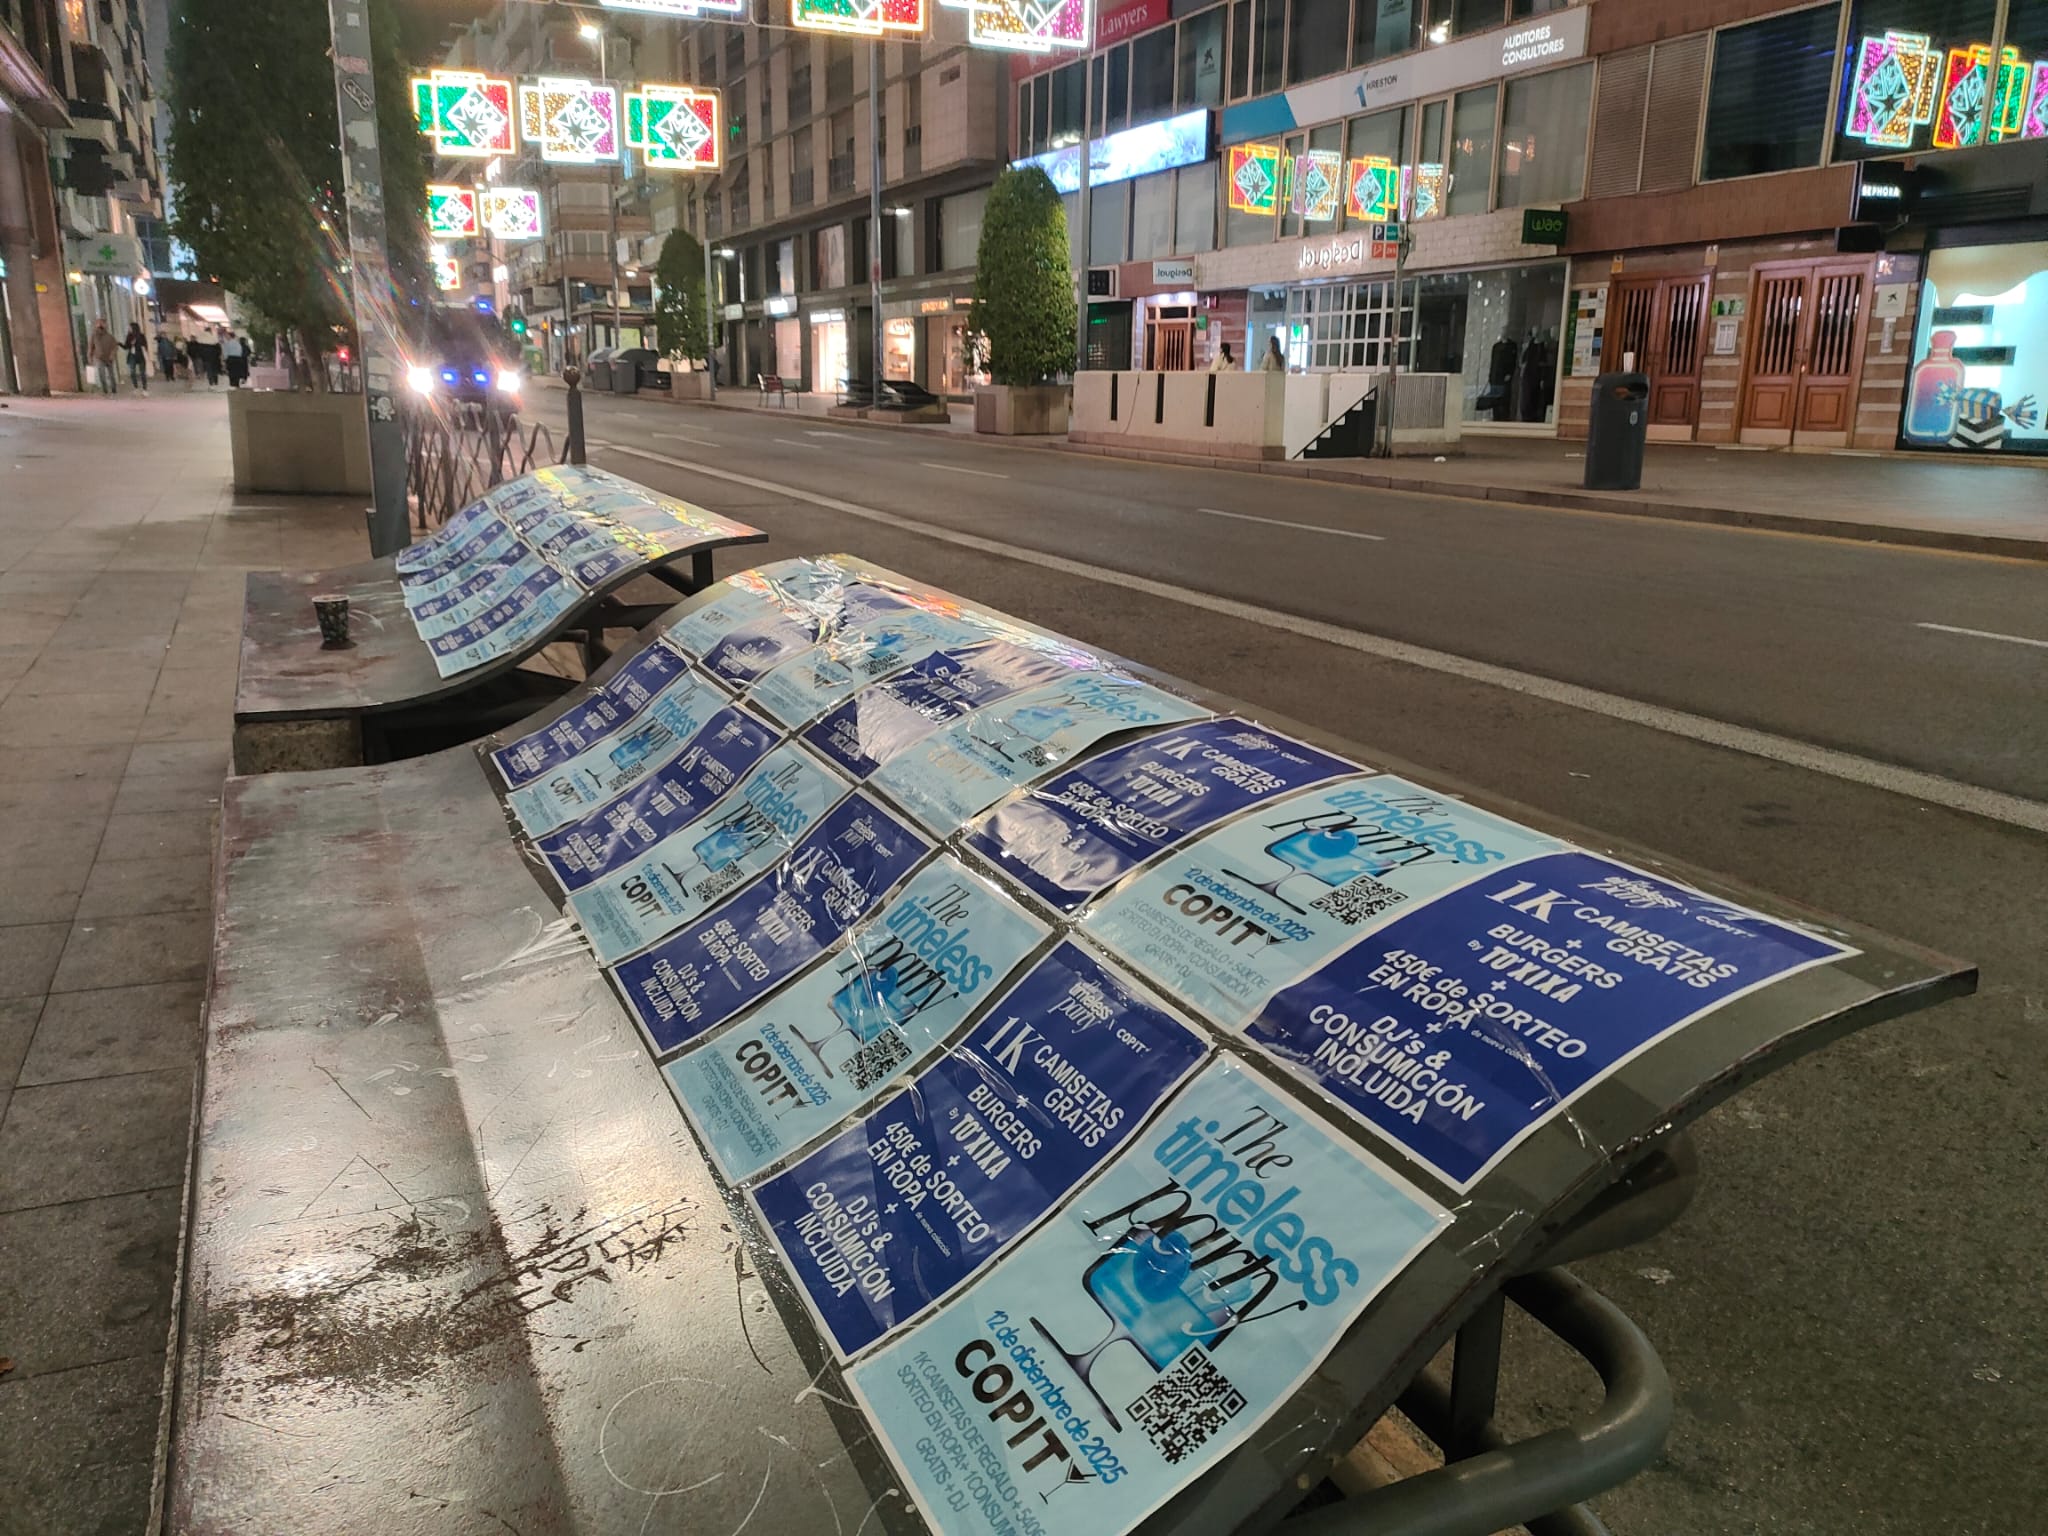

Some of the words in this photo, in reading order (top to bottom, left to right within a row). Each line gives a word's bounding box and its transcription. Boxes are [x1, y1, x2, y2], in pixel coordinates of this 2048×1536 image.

[1100, 4, 1148, 36] Lawyers
[1503, 25, 1550, 50] AUDITORES
[1502, 38, 1565, 65] CONSULTORES
[1862, 184, 1901, 197] SEPHORA
[1375, 225, 1382, 239] P
[1140, 761, 1210, 796] BURGERS
[1151, 736, 1212, 761] 1K
[1201, 748, 1286, 789] CAMISETAS
[1211, 766, 1269, 794] GRATIS
[744, 770, 808, 835] timeless
[1109, 803, 1169, 838] SORTEO
[1323, 790, 1506, 865] timeless
[1383, 794, 1449, 817] The
[1262, 810, 1460, 869] party
[773, 890, 816, 932] BURGERS
[924, 883, 970, 928] The
[1208, 880, 1265, 916] diciembre
[1274, 918, 1316, 942] 2025
[1484, 880, 1584, 924] 1K
[1573, 906, 1739, 979] CAMISETAS
[732, 941, 770, 982] SORTEO
[885, 896, 993, 994] timeless
[1487, 923, 1623, 990] BURGERS
[1606, 938, 1717, 989] GRATIS
[640, 976, 678, 1022] INCLUIDA
[652, 958, 702, 1023] CONSUMICIÓN
[836, 934, 960, 1018] party
[1068, 981, 1114, 1020] timeless
[1367, 964, 1411, 991] EN
[1403, 984, 1477, 1031] ROPA
[1382, 950, 1443, 982] 450€
[1435, 978, 1469, 999] de
[1468, 992, 1588, 1059] SORTEO
[1048, 997, 1102, 1034] party
[1370, 1015, 1426, 1055] DJ's
[1424, 1050, 1452, 1071] &
[980, 1015, 1046, 1077] 1K
[1033, 1045, 1125, 1130] CAMISETAS
[1309, 1004, 1485, 1122] CONSUMICIÓN
[804, 1081, 833, 1107] 2025
[967, 1083, 1042, 1160] BURGERS
[1043, 1088, 1106, 1148] GRATIS
[1214, 1105, 1293, 1179] The
[866, 1137, 896, 1167] EN
[883, 1159, 928, 1212] ROPA
[884, 1121, 922, 1159] 450€
[909, 1154, 932, 1177] de
[925, 1170, 990, 1244] SORTEO
[846, 1195, 878, 1236] DJ's
[870, 1231, 893, 1254] &
[1153, 1116, 1360, 1306] timeless
[793, 1211, 857, 1298] INCLUIDA
[805, 1182, 896, 1303] CONSUMICIÓN
[1082, 1177, 1309, 1336] party
[986, 1310, 1009, 1331] 12
[995, 1327, 1021, 1349] de
[897, 1364, 935, 1414] SORTEO
[925, 1410, 947, 1433] EN
[1010, 1345, 1073, 1421] diciembre
[912, 1351, 933, 1369] 1K
[923, 1365, 972, 1431] CAMISETAS
[962, 1426, 985, 1450] DE
[974, 1444, 1019, 1502] REGALO
[1063, 1416, 1091, 1442] de
[916, 1437, 953, 1486] GRATIS
[950, 1490, 970, 1513] DJ
[1079, 1436, 1129, 1485] 2025
